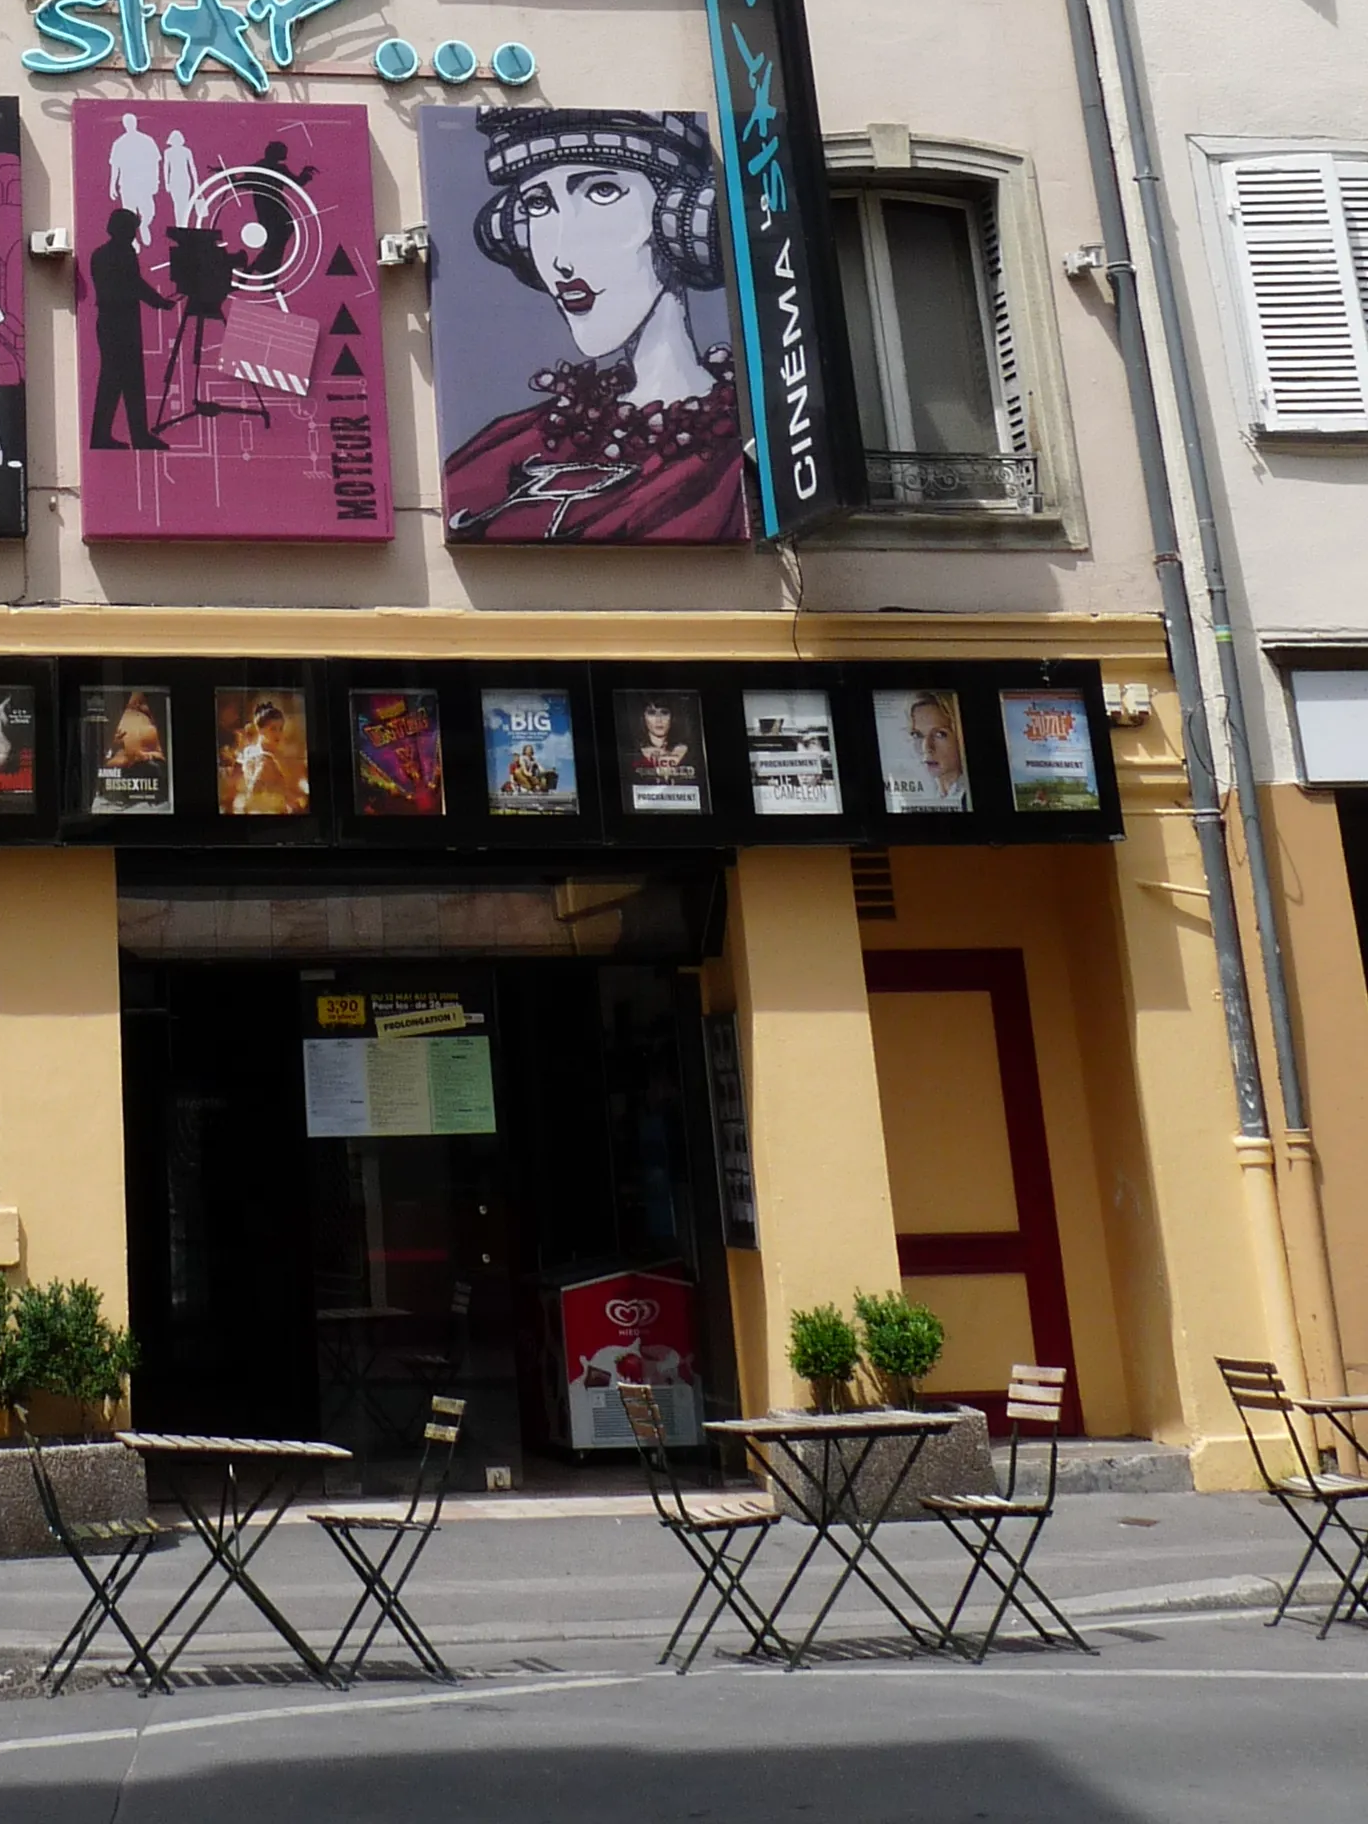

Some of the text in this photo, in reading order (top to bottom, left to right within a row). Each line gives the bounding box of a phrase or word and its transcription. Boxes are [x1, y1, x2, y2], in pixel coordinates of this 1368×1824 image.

[774, 237, 818, 501] CINÉMA
[330, 408, 379, 522] MOTEUR
[511, 711, 551, 731] BIG
[105, 778, 159, 791] BISSEXTILE
